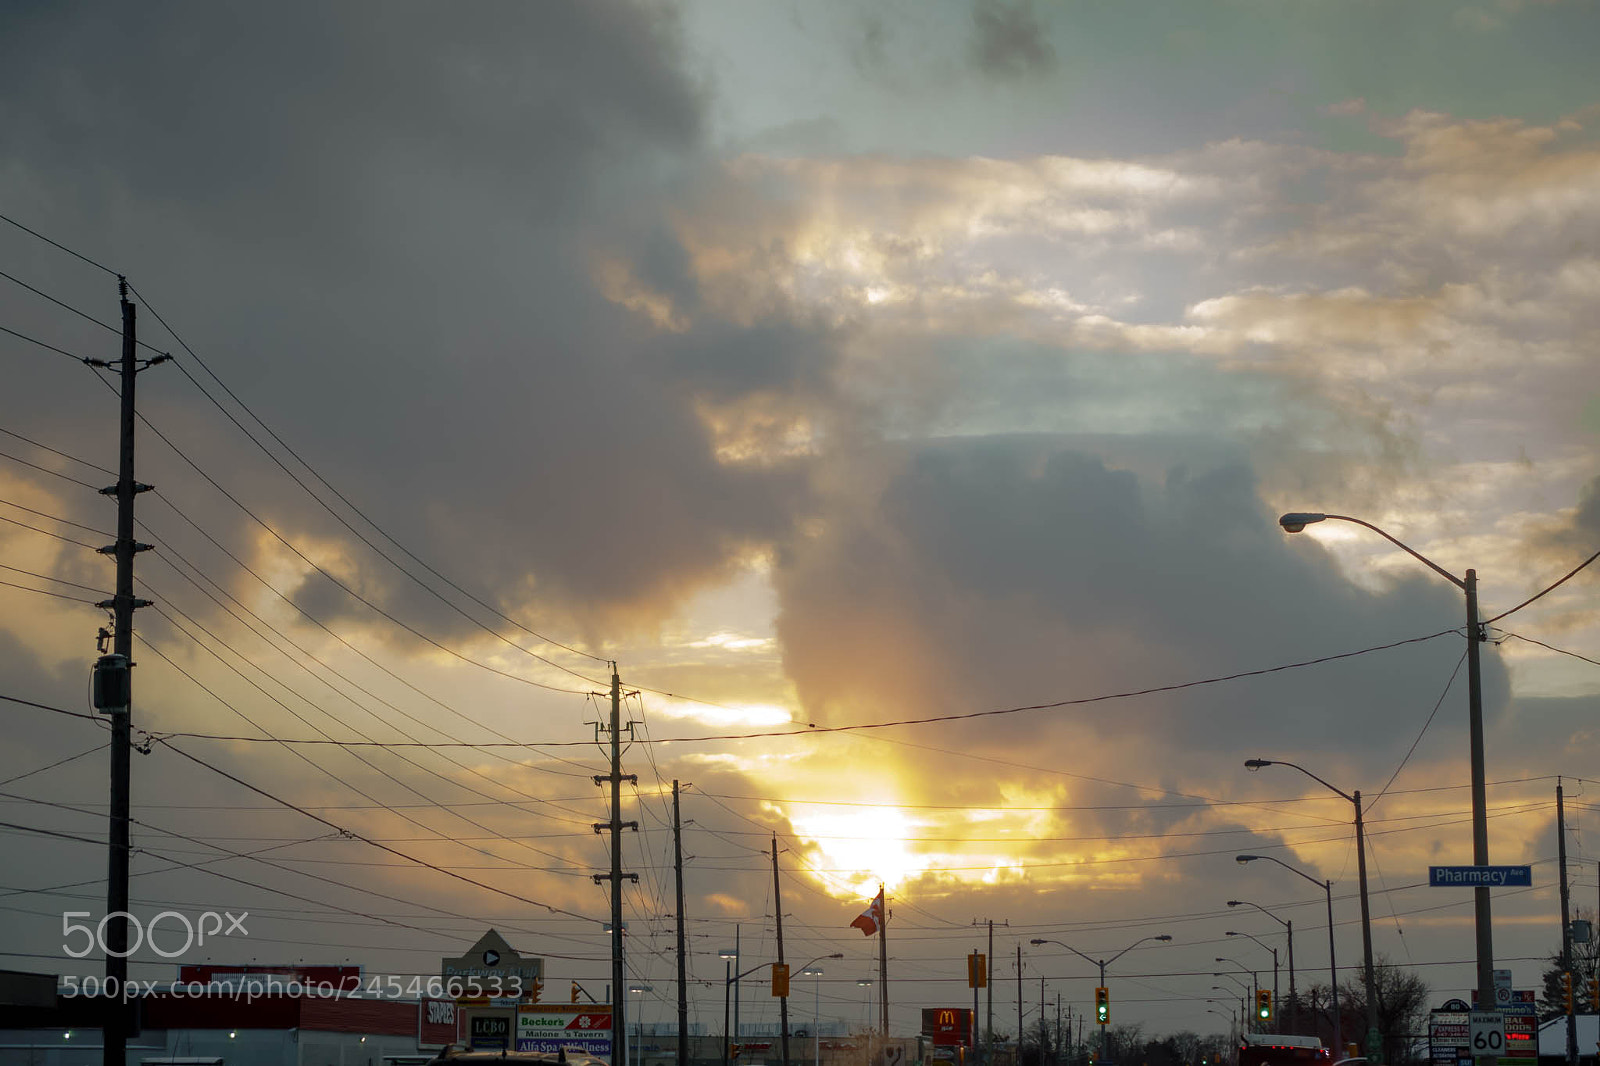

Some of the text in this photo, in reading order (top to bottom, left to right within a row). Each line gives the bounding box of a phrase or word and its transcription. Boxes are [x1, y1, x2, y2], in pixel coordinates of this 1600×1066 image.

[1436, 868, 1507, 885] Pharmacy
[427, 1002, 455, 1025] STAPLES
[1472, 1016, 1502, 1024] MAXIMUM
[475, 1020, 506, 1034] LCBO
[521, 1017, 564, 1026] Becker's
[519, 1041, 539, 1051] Alfa
[540, 1041, 557, 1053] Spa
[566, 1041, 609, 1052] Wellness
[1474, 1031, 1502, 1050] 60
